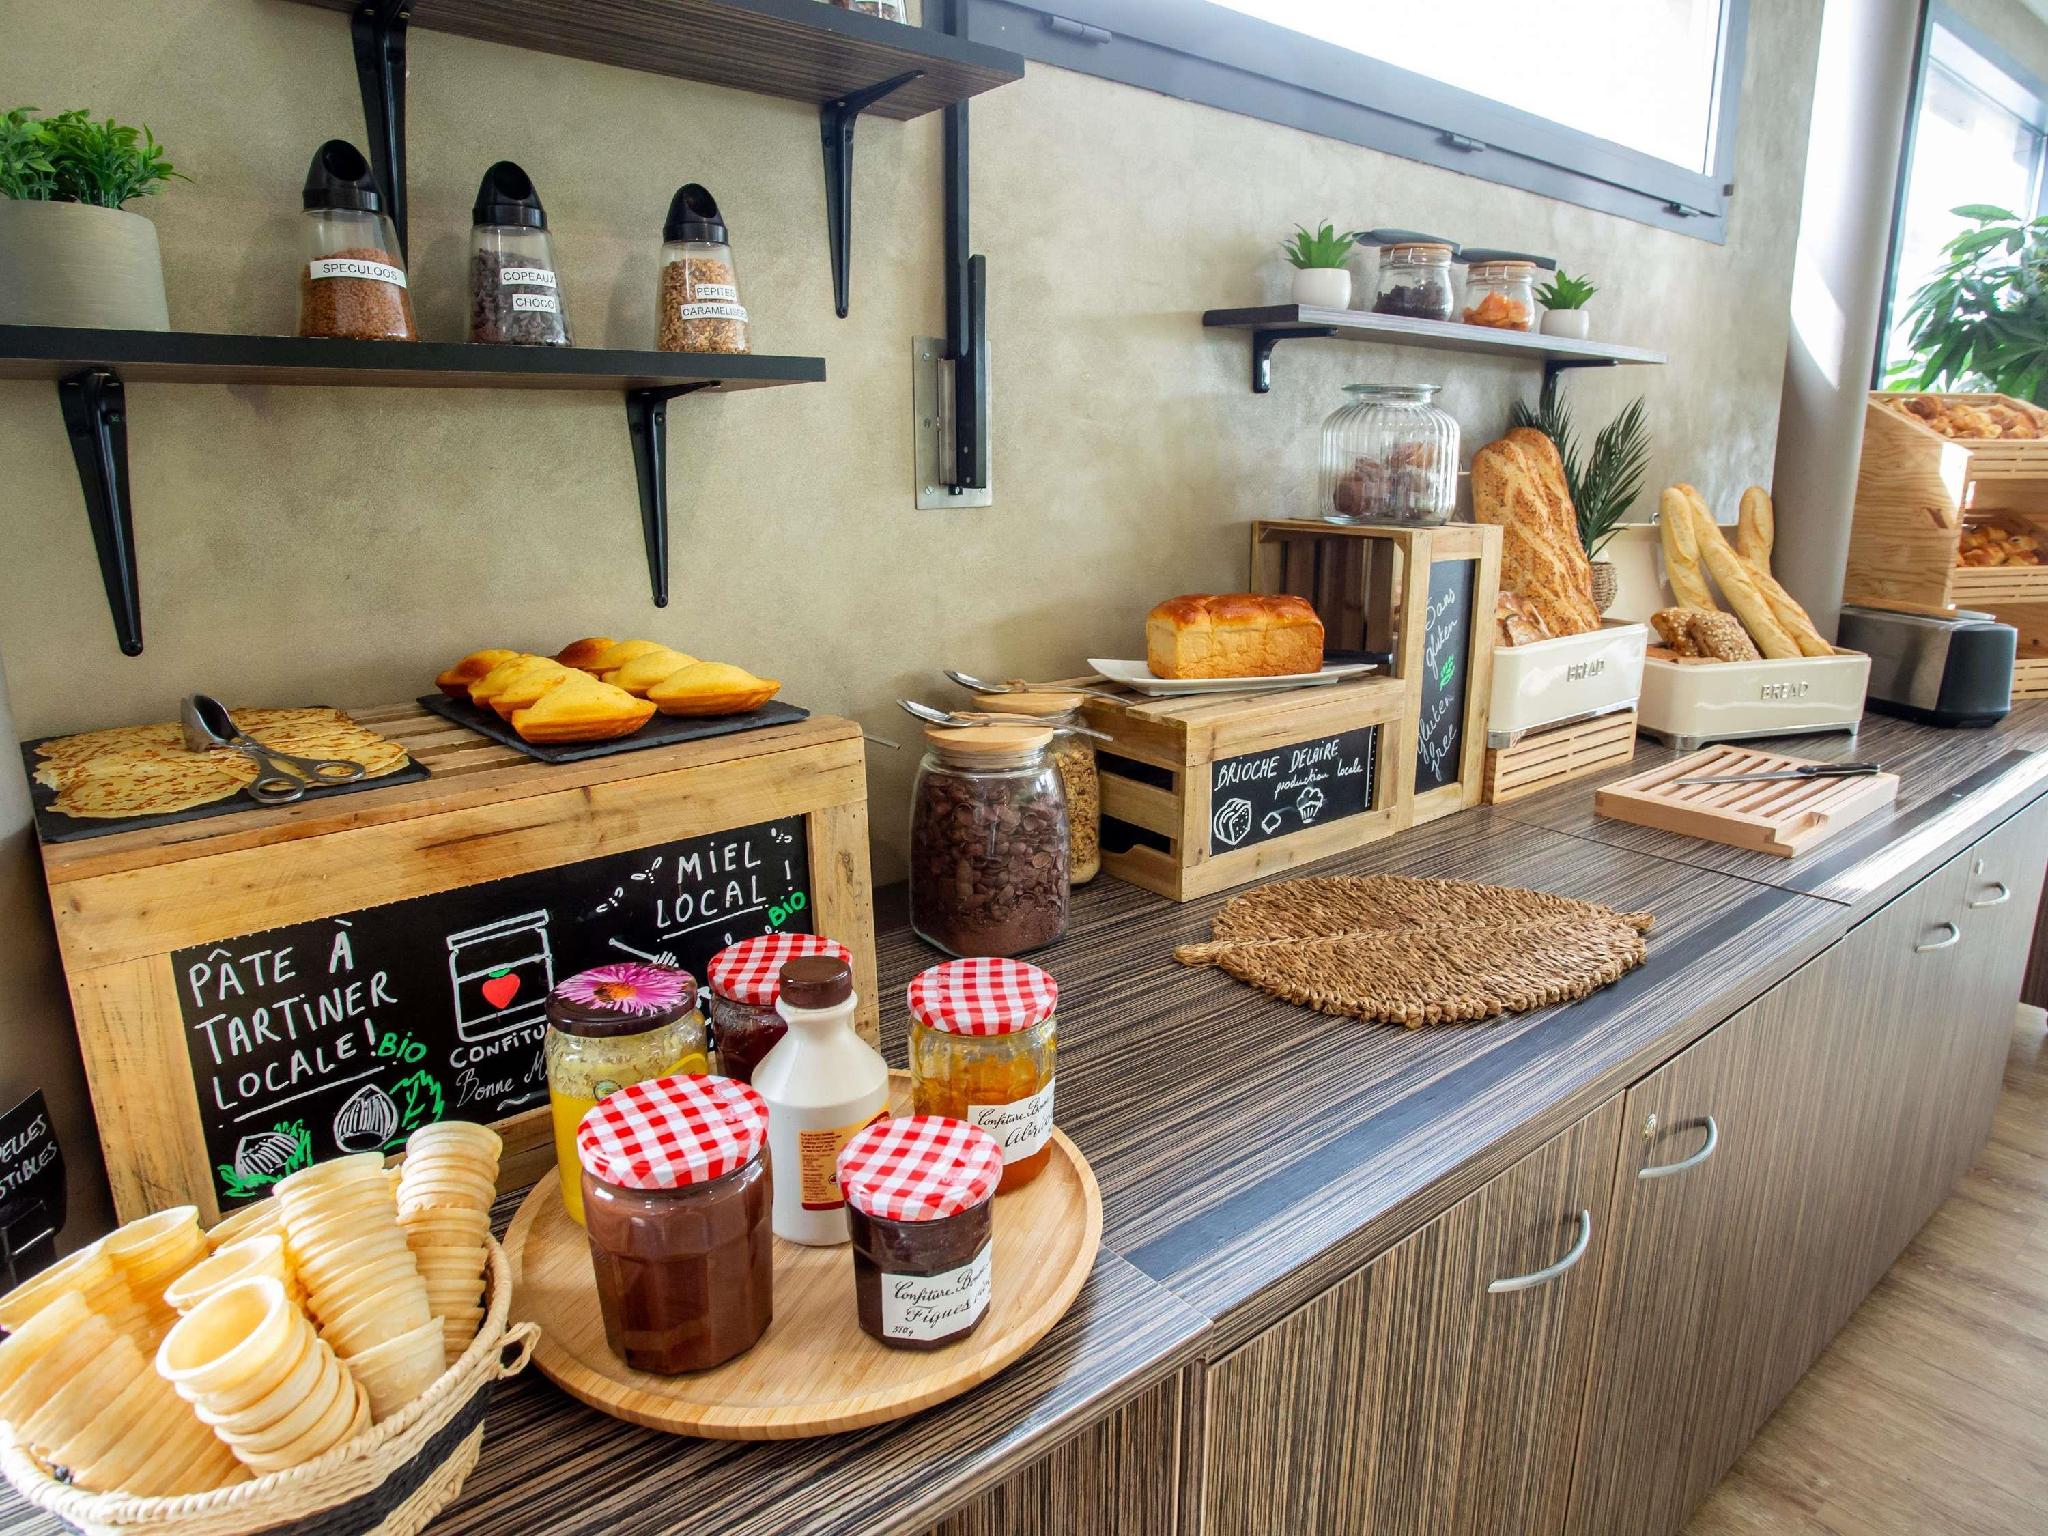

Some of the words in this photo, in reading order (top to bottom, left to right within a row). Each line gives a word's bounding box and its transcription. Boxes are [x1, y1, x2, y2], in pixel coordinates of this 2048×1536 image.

[323, 263, 398, 280] SPECULOOS
[515, 297, 555, 310] CHOCO
[1566, 658, 1605, 682] BREAD
[1760, 680, 1809, 700] BREAD
[188, 945, 296, 1008] PÂTE
[455, 1067, 516, 1108] Bonne
[894, 1280, 952, 1306] Confiture
[904, 1299, 973, 1329] Figues
